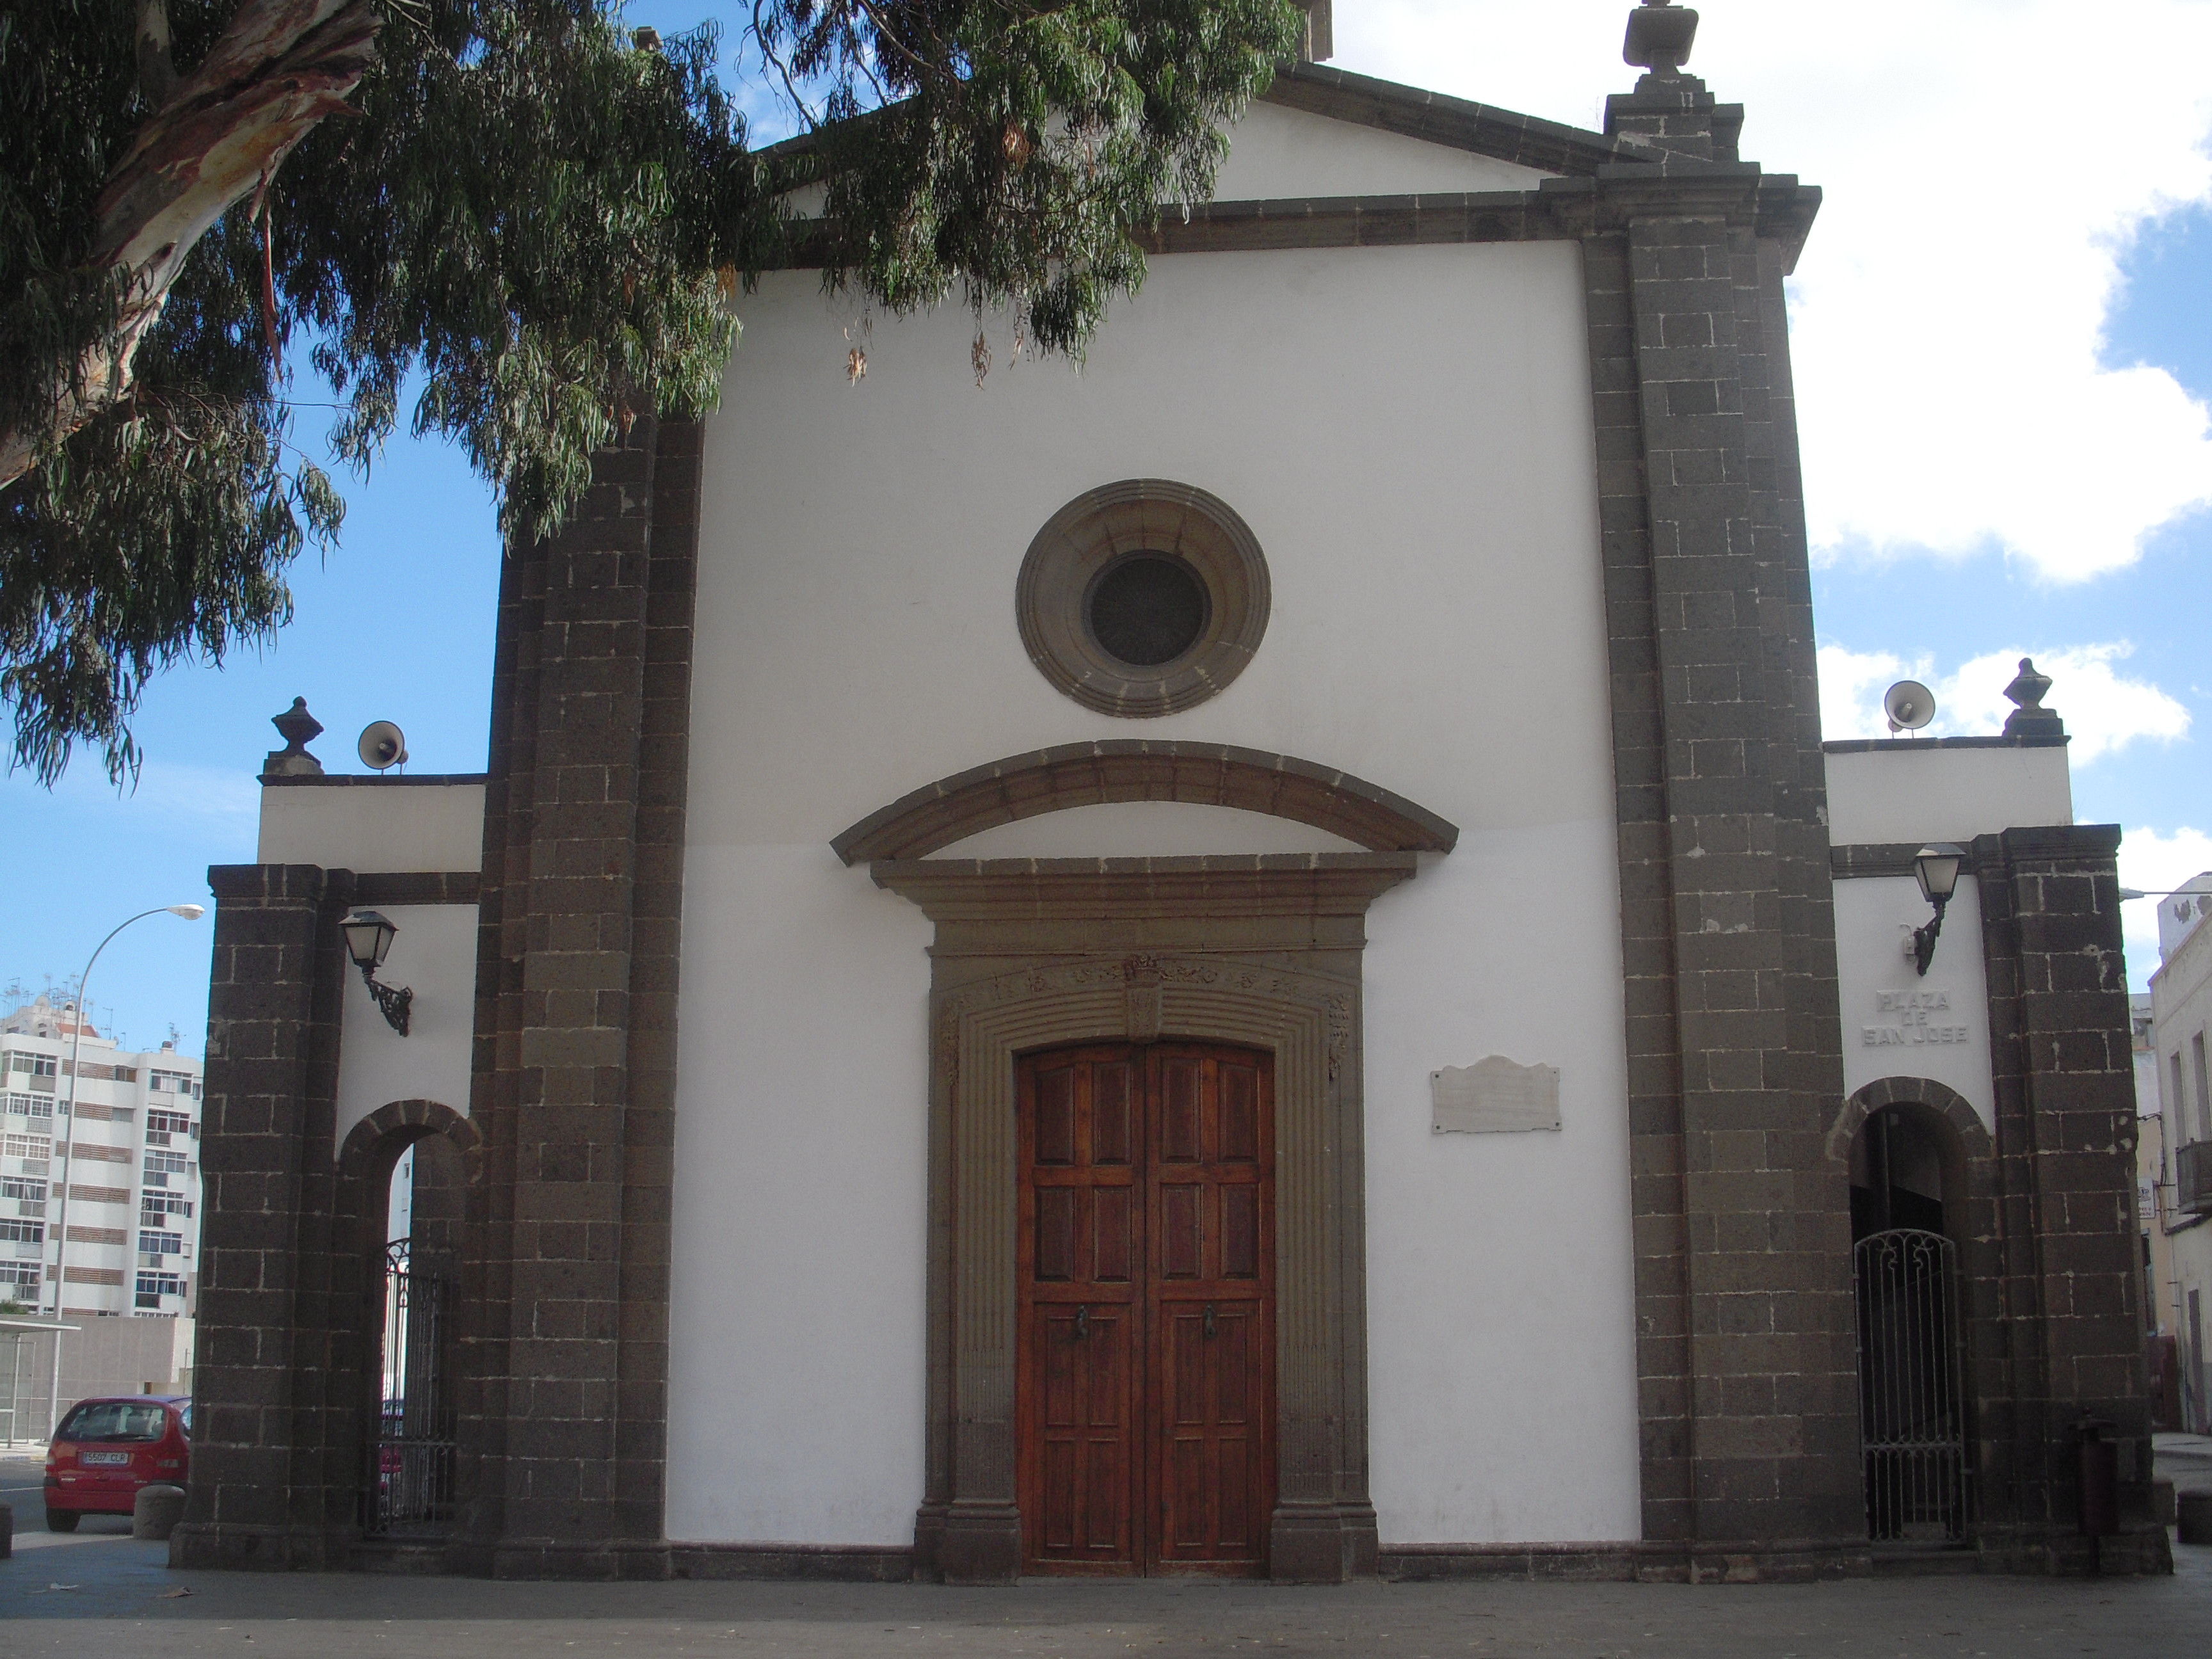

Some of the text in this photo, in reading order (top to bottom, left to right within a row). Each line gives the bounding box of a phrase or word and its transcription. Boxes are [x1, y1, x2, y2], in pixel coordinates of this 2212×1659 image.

[1879, 991, 1950, 1011] PLAZA
[1901, 1009, 1928, 1026] DE
[1863, 1027, 1905, 1045] SAN
[88, 1453, 108, 1461] 5507
